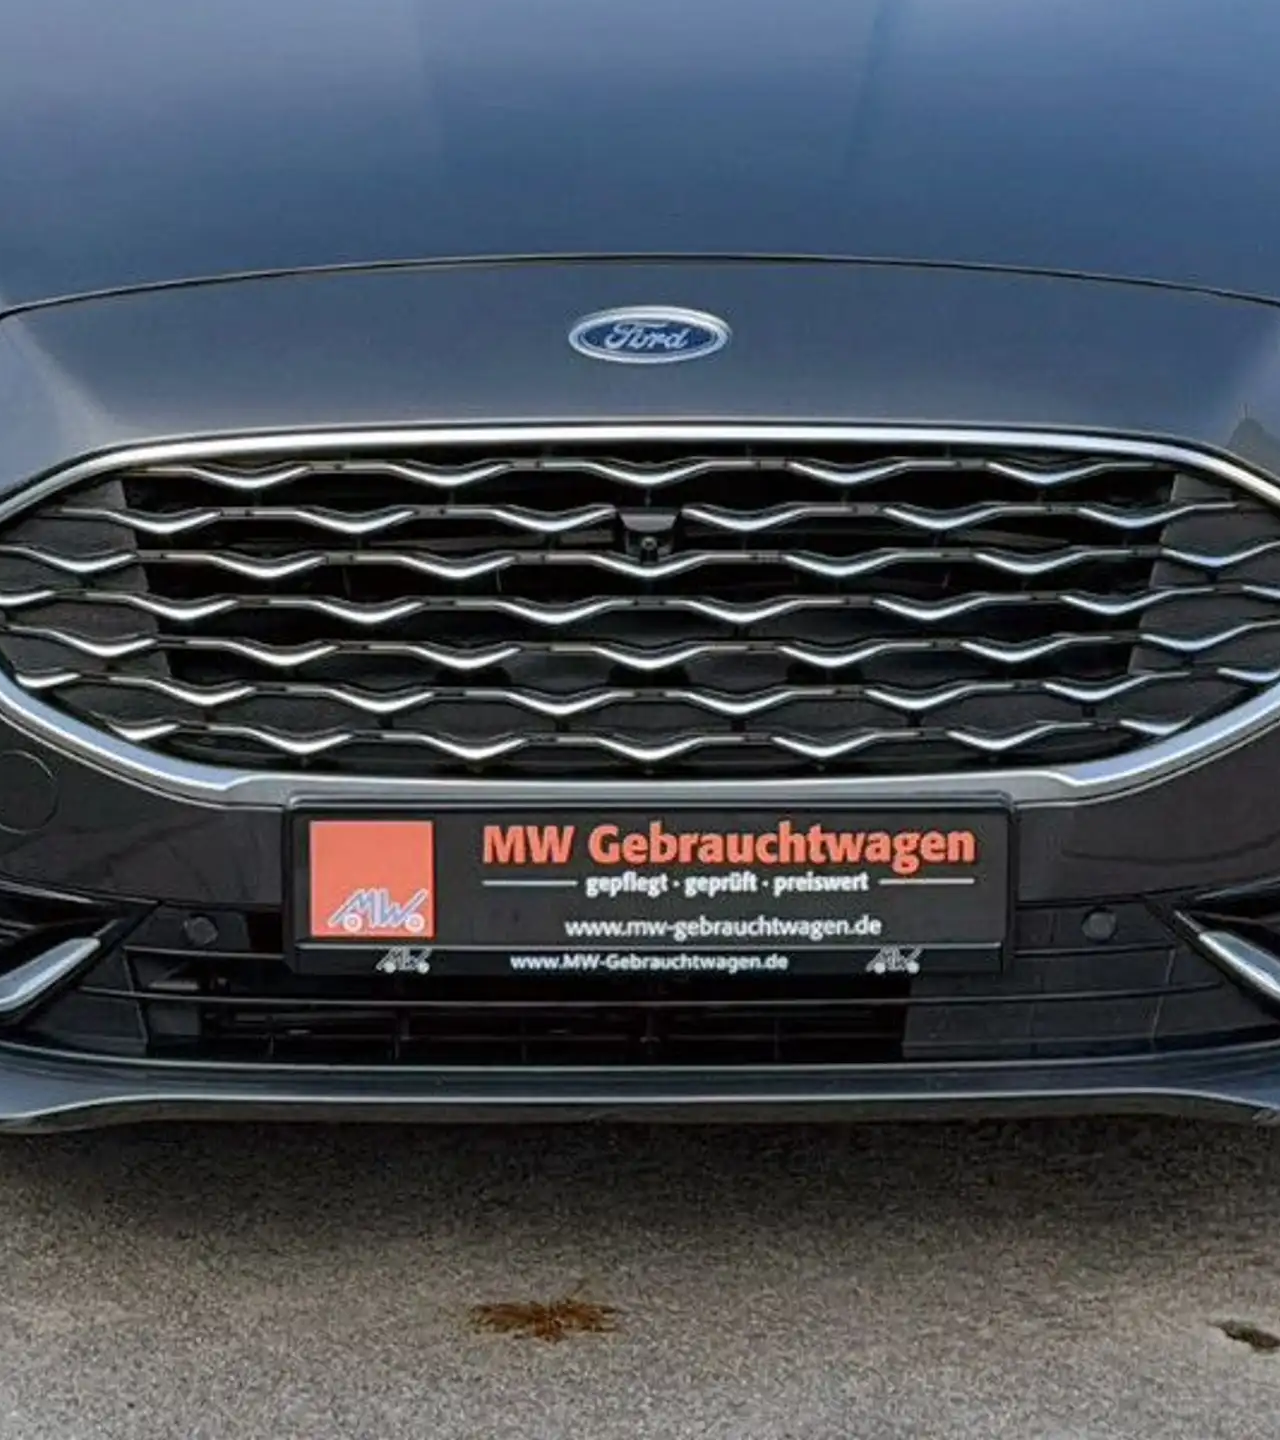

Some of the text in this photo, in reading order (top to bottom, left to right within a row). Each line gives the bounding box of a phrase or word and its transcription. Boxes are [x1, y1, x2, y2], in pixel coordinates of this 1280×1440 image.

[604, 322, 691, 350] Ford
[482, 820, 976, 875] MW Gebrauchtwagen
[585, 871, 870, 898] gepflegt geprüft preiswert
[564, 914, 883, 942] www.mw-gebrauchtwagen.de
[509, 952, 789, 974] www.MW-Gebrauchtwagen.de
